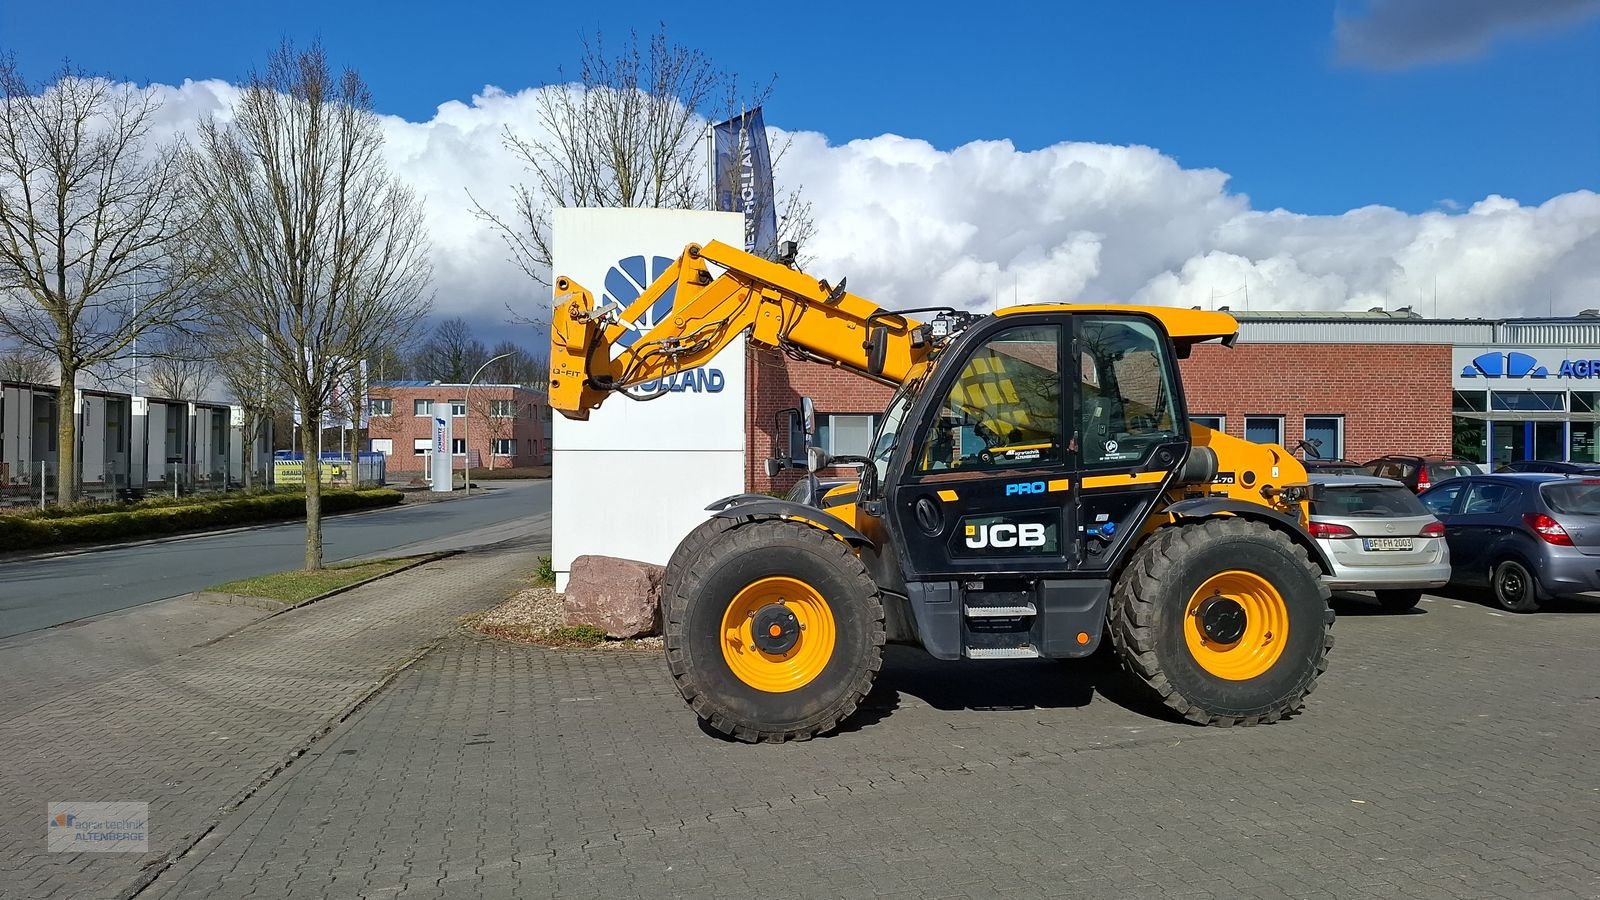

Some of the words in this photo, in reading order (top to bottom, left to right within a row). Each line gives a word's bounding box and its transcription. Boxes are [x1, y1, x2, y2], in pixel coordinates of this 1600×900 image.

[552, 368, 581, 378] Q-FIT
[1005, 481, 1046, 496] PRO
[965, 523, 1047, 549] JCB
